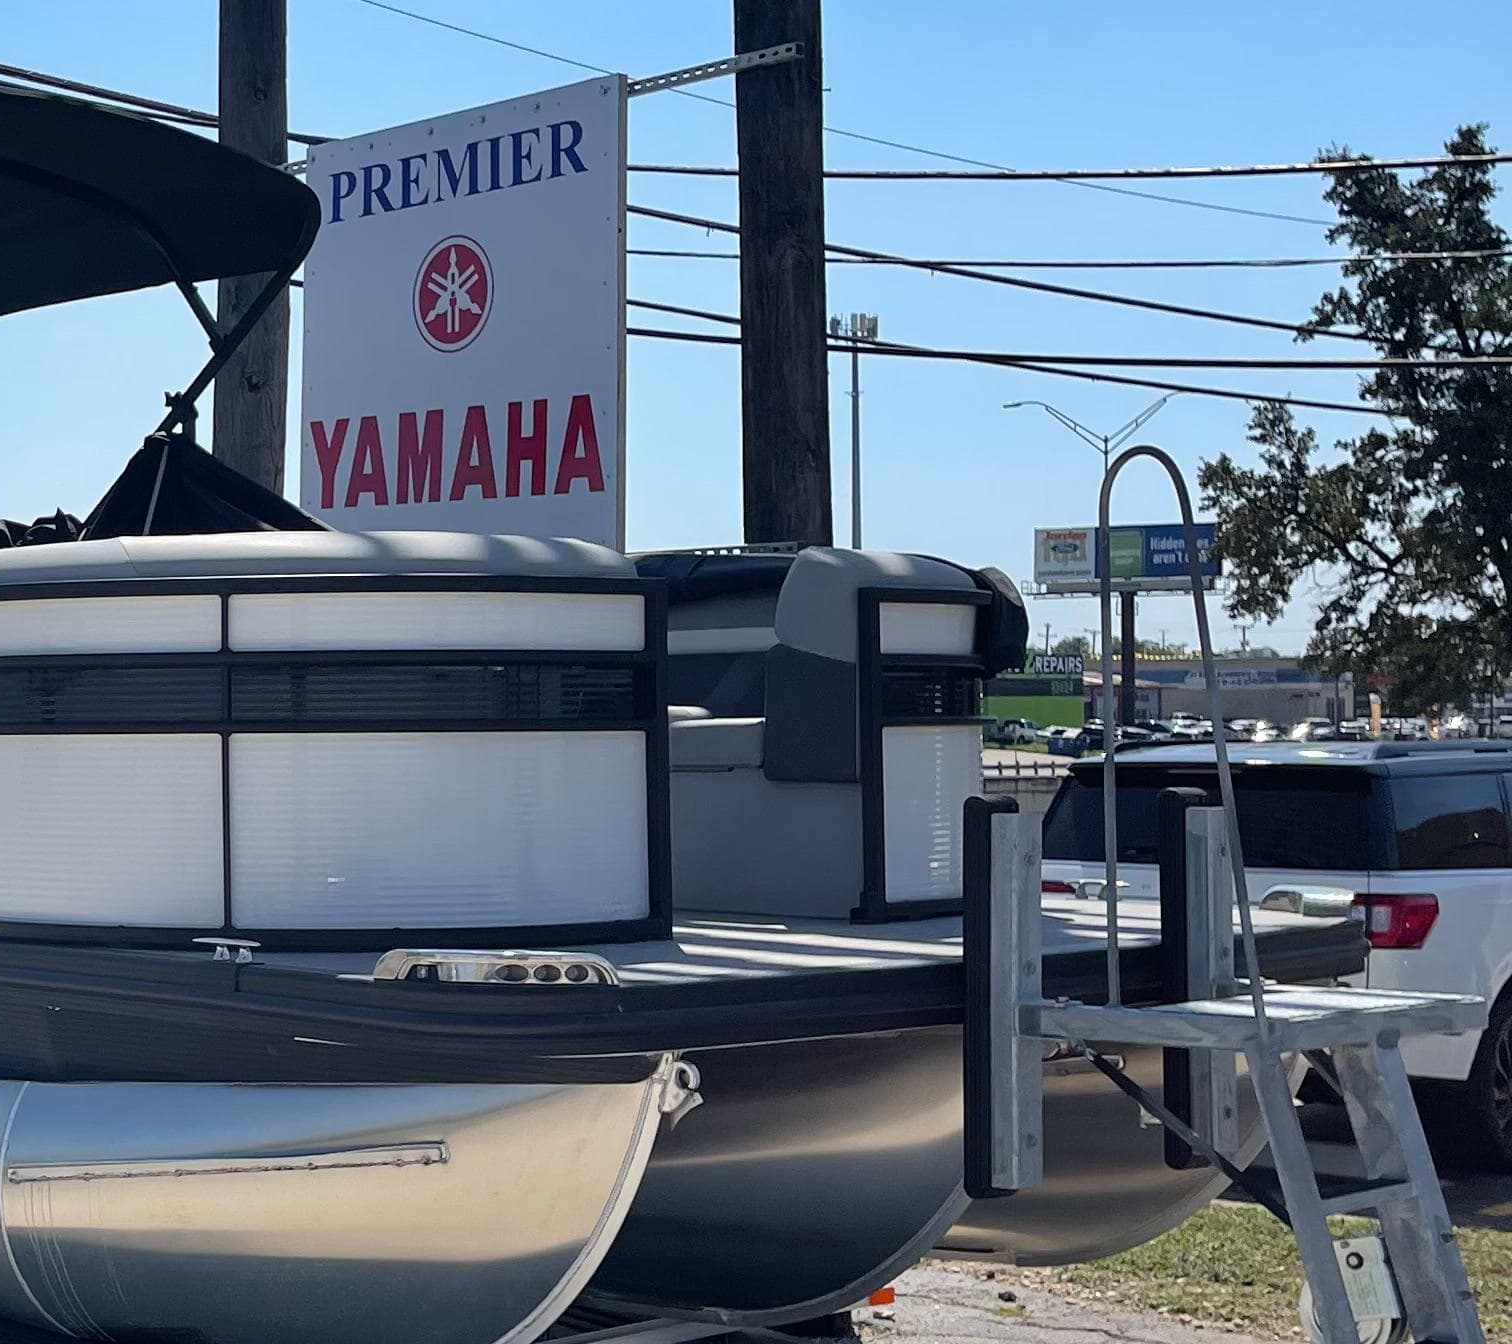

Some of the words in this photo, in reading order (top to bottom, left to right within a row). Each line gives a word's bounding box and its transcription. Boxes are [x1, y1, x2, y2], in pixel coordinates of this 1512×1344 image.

[327, 119, 589, 224] PREMIER
[309, 393, 605, 510] YAMAHA
[1035, 656, 1083, 673] REPAIRS
